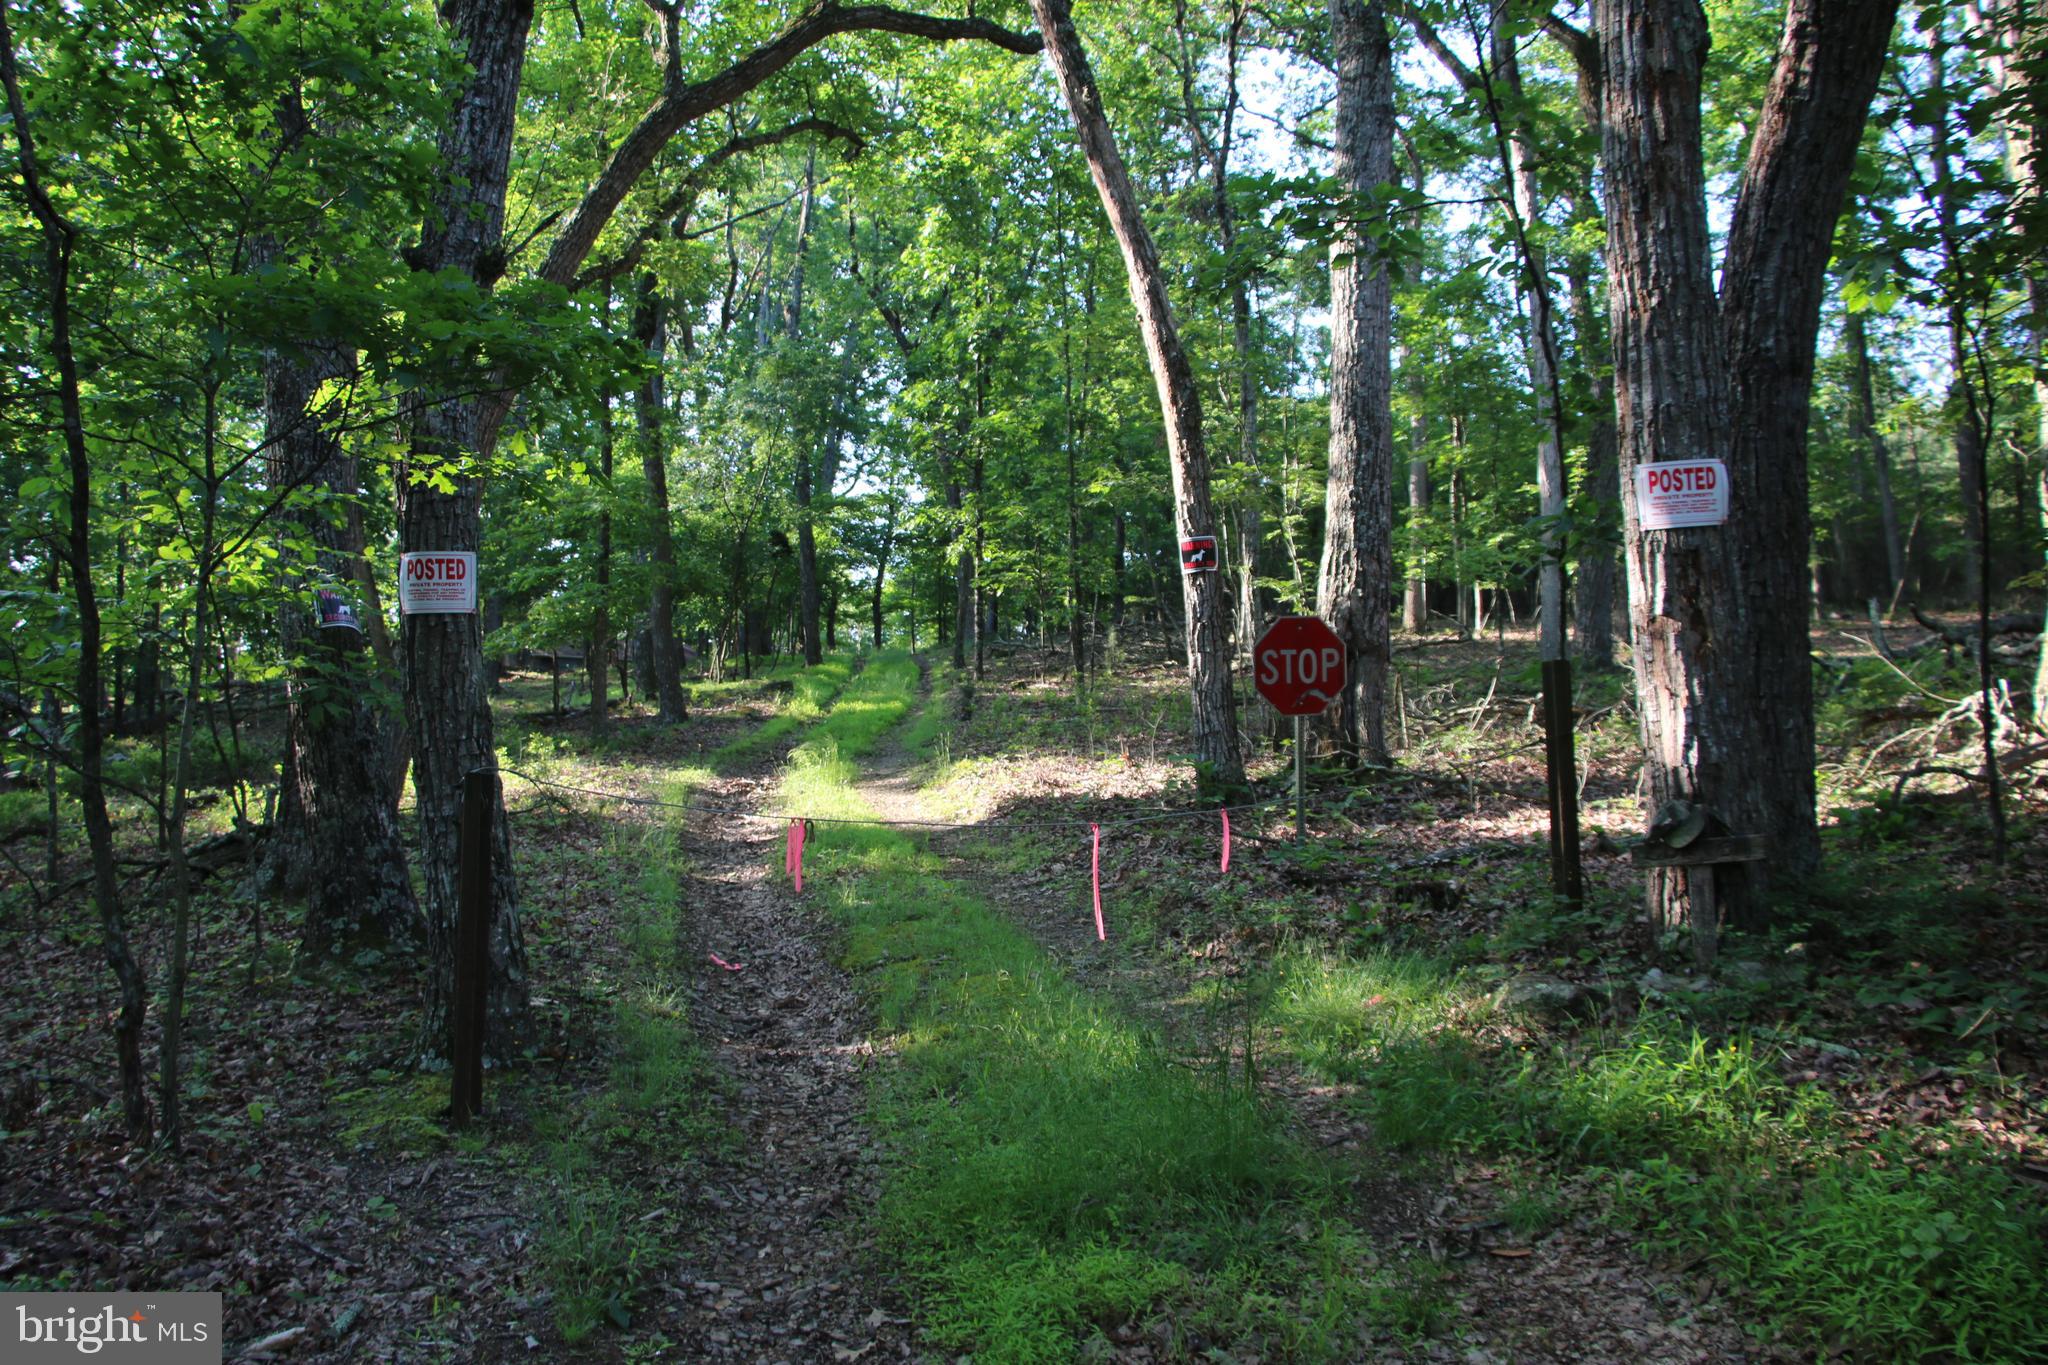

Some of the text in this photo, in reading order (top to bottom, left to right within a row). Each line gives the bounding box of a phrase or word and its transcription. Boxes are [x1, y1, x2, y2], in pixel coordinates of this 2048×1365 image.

[1647, 466, 1716, 494] POSTED
[407, 558, 466, 581] POSTED
[1260, 647, 1340, 685] STOP
